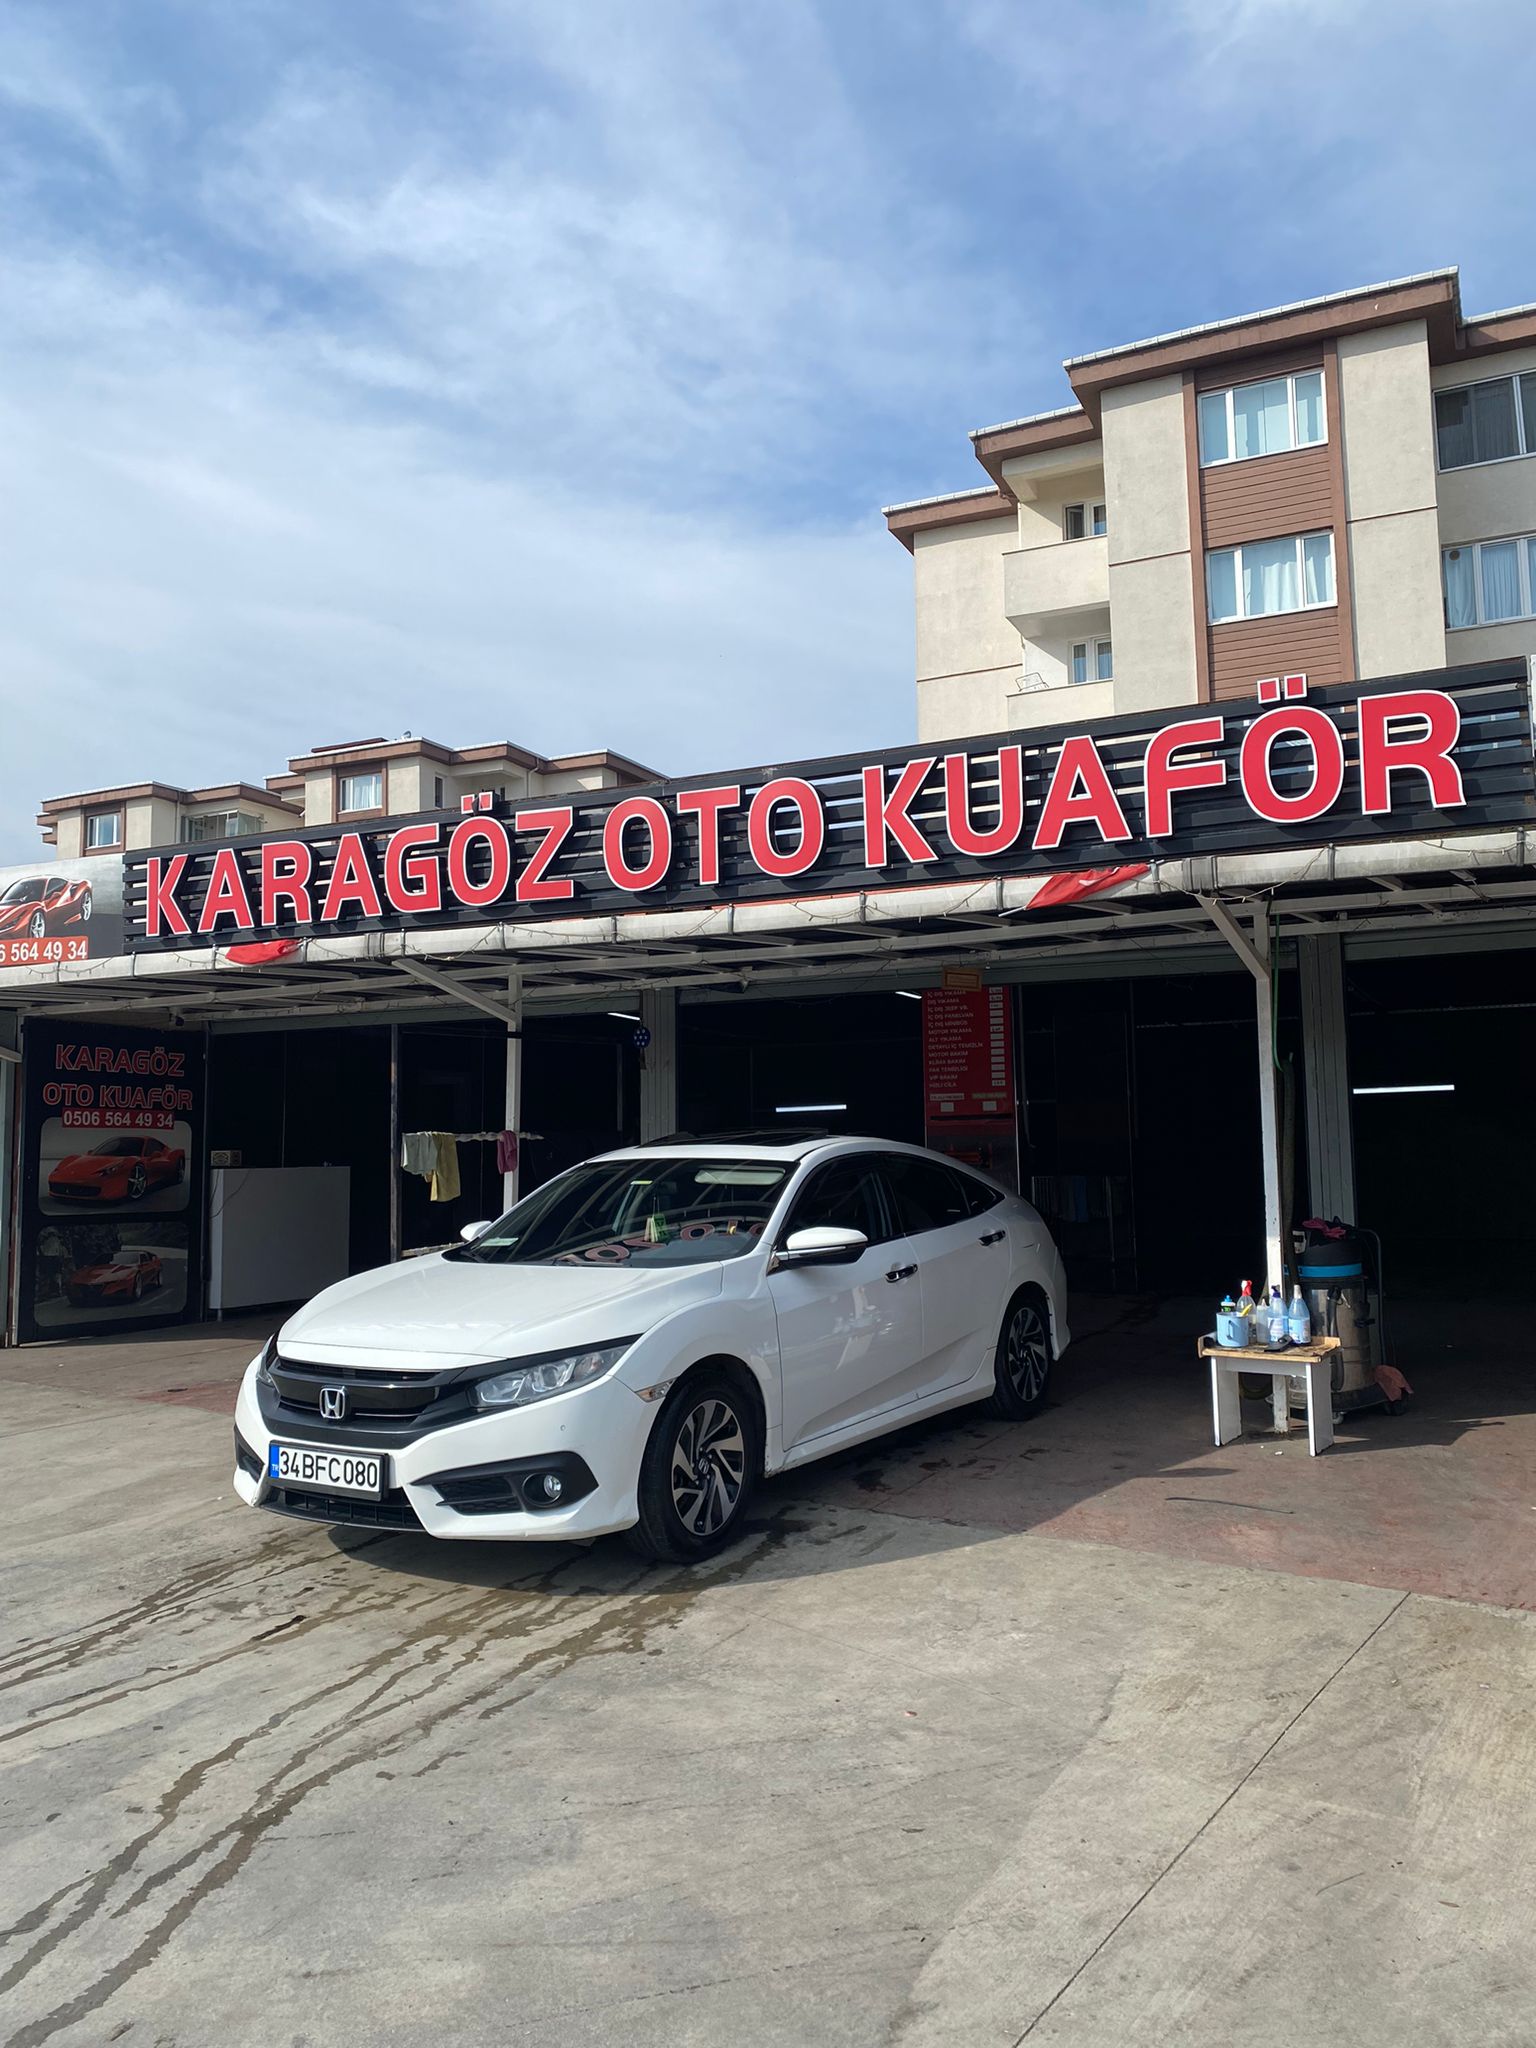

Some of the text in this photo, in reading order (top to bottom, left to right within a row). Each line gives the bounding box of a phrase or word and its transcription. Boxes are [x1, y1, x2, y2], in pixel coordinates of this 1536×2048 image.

[146, 673, 1467, 937] KARAGÖZ OTO KUAFÖR
[11, 942, 39, 961] 564
[43, 941, 63, 960] 49
[67, 940, 87, 959] 34
[55, 1043, 185, 1077] KARAGÖZ
[42, 1082, 193, 1111] OTO KUAFÖR
[63, 1110, 173, 1128] 0506 564 49 34
